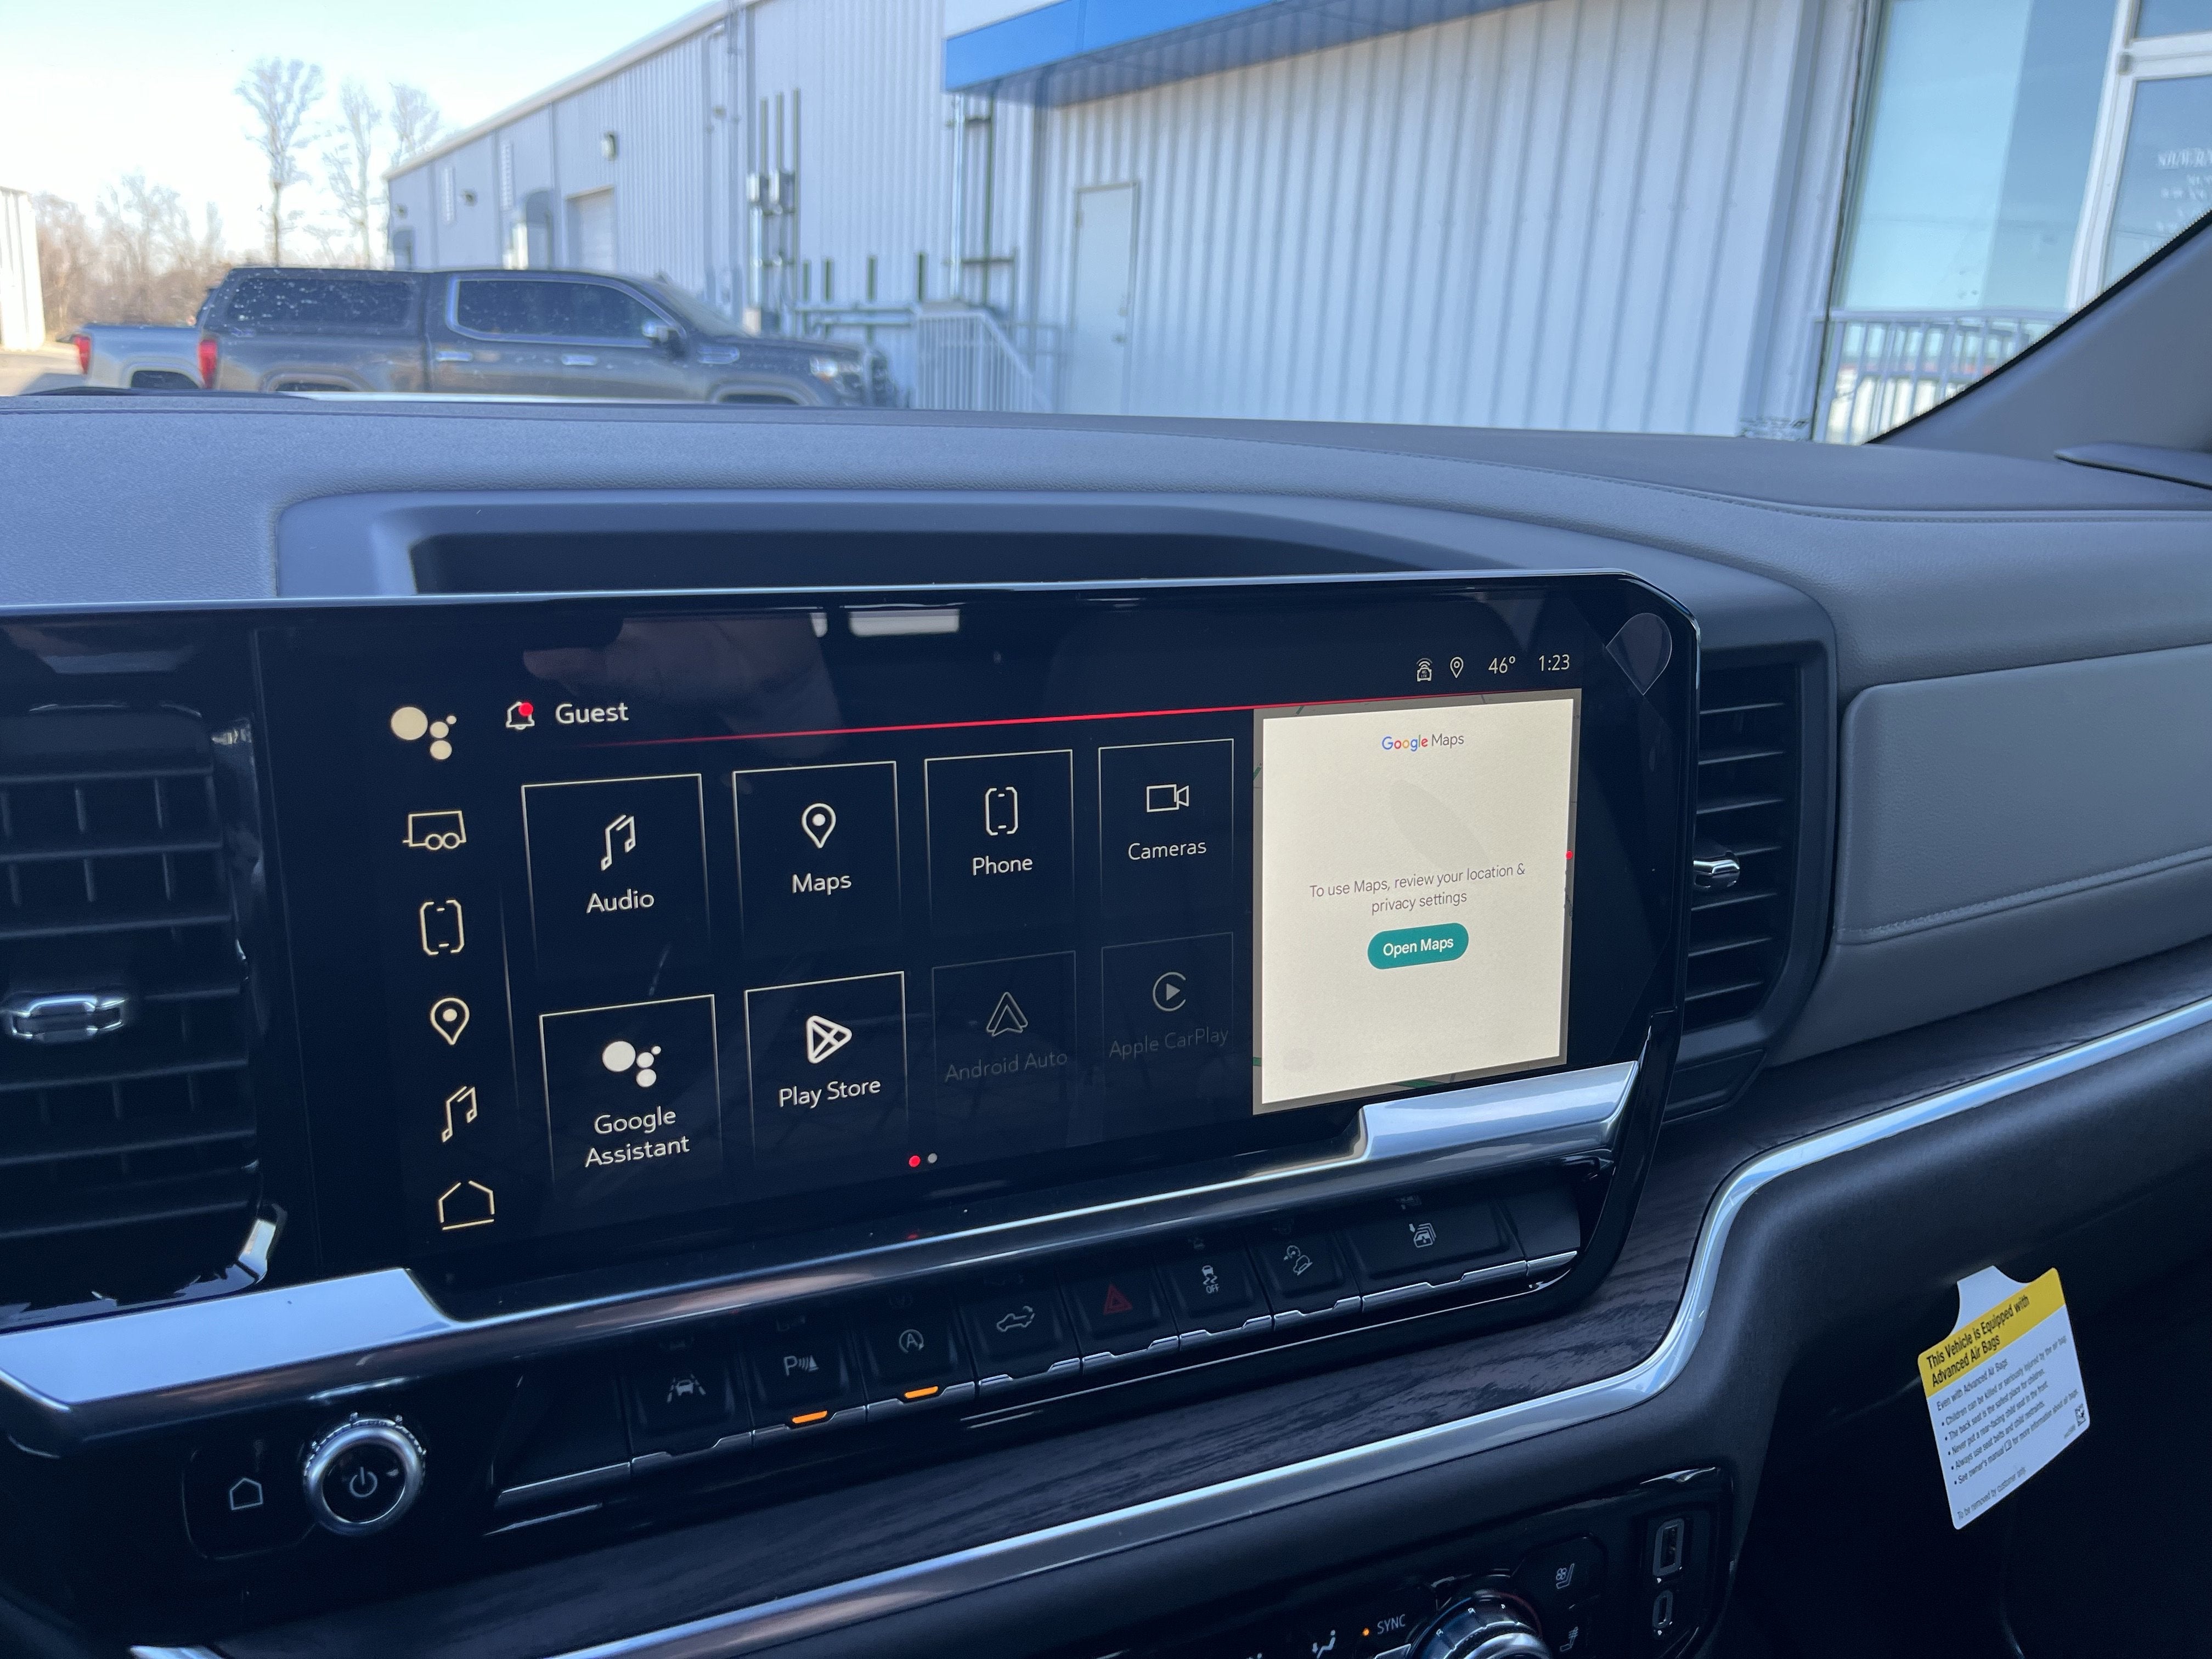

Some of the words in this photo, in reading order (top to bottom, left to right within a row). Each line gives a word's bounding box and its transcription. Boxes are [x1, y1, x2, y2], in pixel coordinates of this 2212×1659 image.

[1538, 654, 1571, 672] 1:23
[555, 702, 629, 724] Guest
[1381, 734, 1428, 752] Google
[1431, 733, 1464, 749] Maps
[1128, 841, 1207, 860] Cameras
[972, 855, 1034, 876] Phone
[792, 873, 852, 895] Maps
[1310, 884, 1324, 898] To
[1328, 883, 1350, 896] use
[1353, 879, 1391, 894] Maps,
[1394, 873, 1434, 889] review
[1437, 870, 1464, 888] your
[1466, 864, 1513, 881] location
[1516, 862, 1525, 876] &
[586, 888, 654, 913] Audio
[1372, 896, 1416, 916] privacy
[1419, 891, 1468, 908] settings
[1383, 940, 1417, 958] Open
[1420, 936, 1454, 952] Maps
[1109, 1034, 1159, 1059] Apple
[1165, 1026, 1229, 1049] CarPlay
[945, 1054, 1019, 1082] Android
[1024, 1051, 1068, 1071] Auto
[778, 1085, 822, 1108] Play
[826, 1079, 881, 1102] Store
[594, 1105, 676, 1135] Google
[584, 1135, 691, 1168] Assistant
[1206, 1283, 1220, 1294] OFF
[1926, 1351, 1945, 1369] This
[1944, 1333, 1973, 1358] Vehicle
[1973, 1328, 1980, 1340] is
[1980, 1304, 2013, 1334] Equipped
[2014, 1295, 2030, 1313] with
[1932, 1353, 1970, 1387] Advanced
[1970, 1346, 1980, 1363] Air
[1981, 1335, 2000, 1354] Bags
[1937, 1397, 1951, 1411] Even
[1951, 1389, 1963, 1401] with
[1964, 1371, 1988, 1393] Advanced
[1995, 1359, 2007, 1372] Bags
[1946, 1407, 1967, 1425] Children
[1968, 1401, 1977, 1411] can
[1977, 1396, 1984, 1404] be
[1984, 1385, 1997, 1398] killed
[1949, 1430, 1958, 1440] The
[1959, 1420, 1971, 1434] back
[1972, 1413, 1982, 1425] seat
[1952, 1440, 1966, 1454] Never
[1967, 1433, 1976, 1447] put
[1956, 1453, 1973, 1470] Always
[1973, 1447, 1982, 1457] use
[1983, 1437, 1993, 1451] seat
[1958, 1473, 1968, 1484] See
[1957, 1511, 1964, 1520] To
[1964, 1507, 1971, 1516] be
[1377, 1613, 1406, 1635] SYNC
